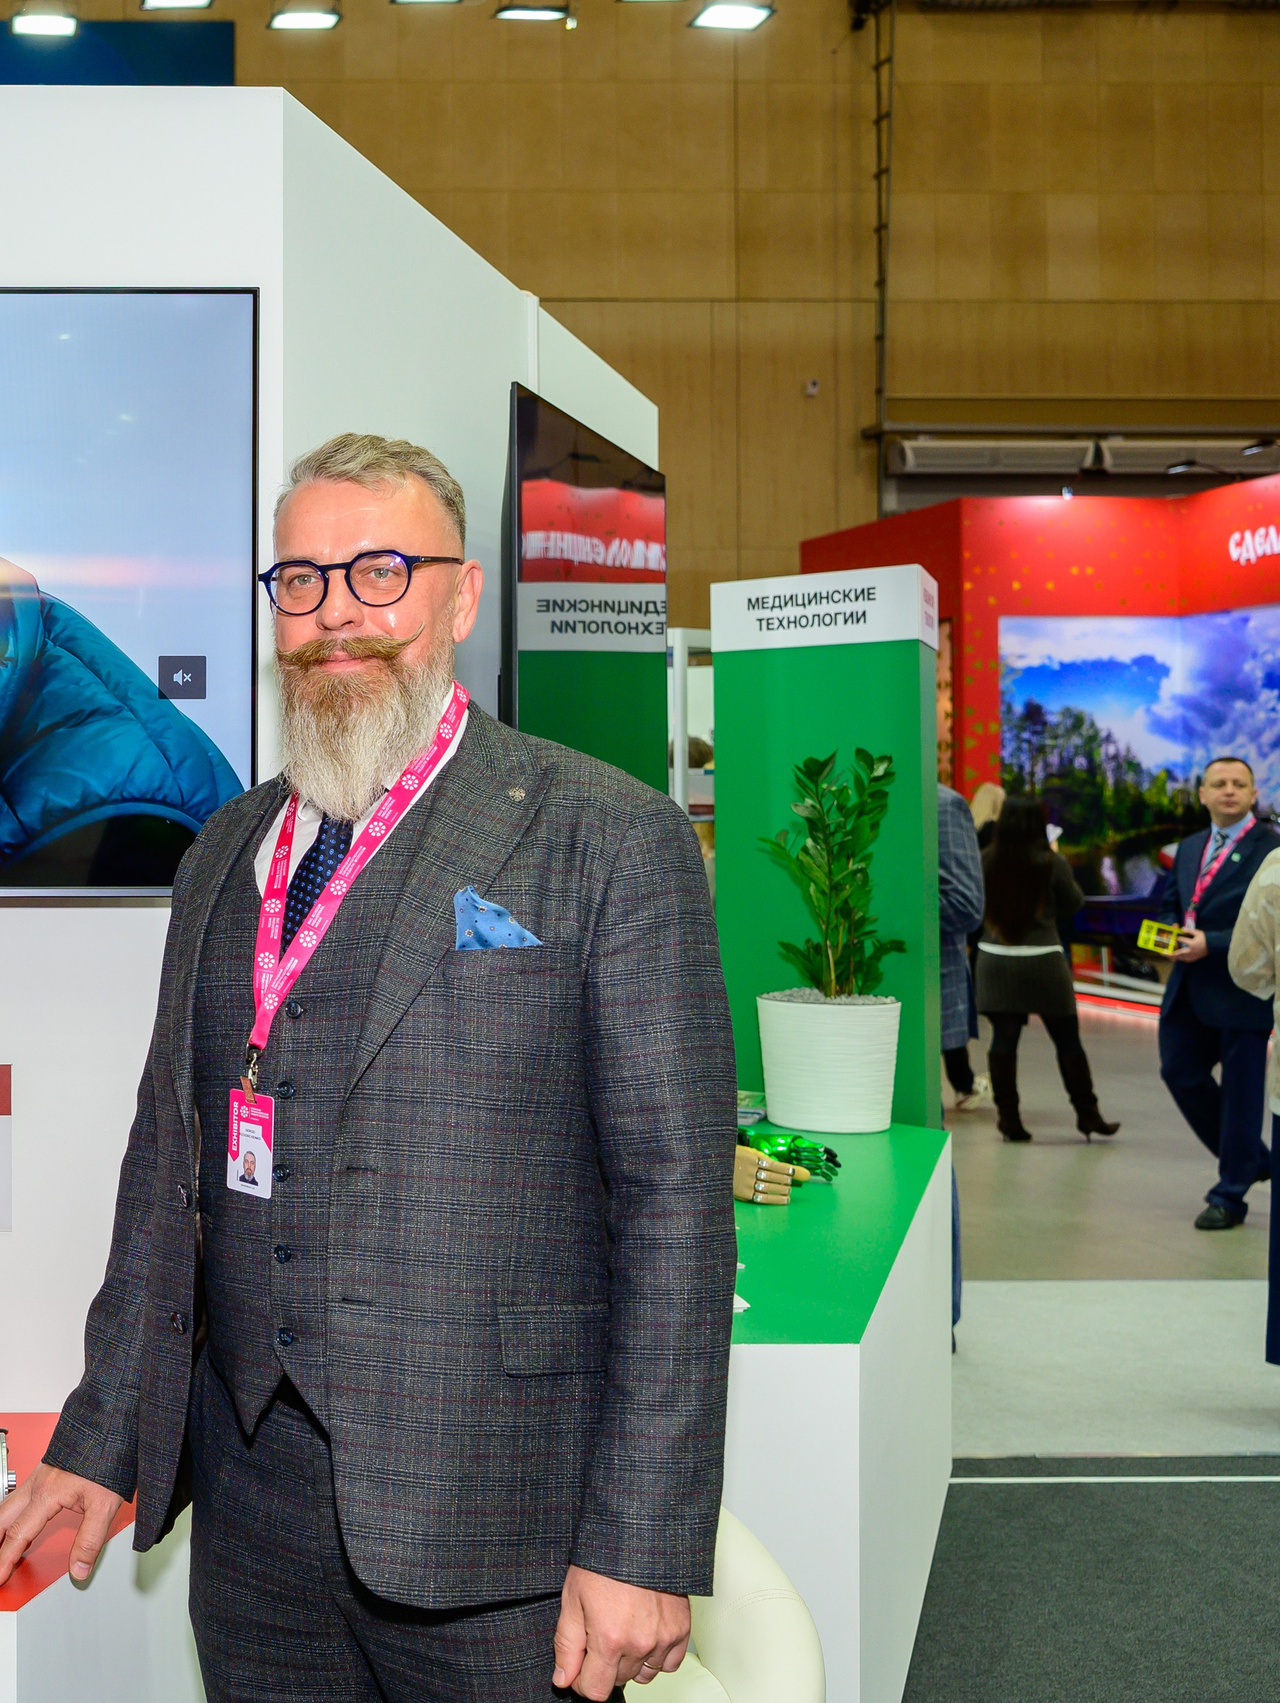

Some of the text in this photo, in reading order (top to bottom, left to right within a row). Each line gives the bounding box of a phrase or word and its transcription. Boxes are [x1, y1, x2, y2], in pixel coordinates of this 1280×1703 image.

[1228, 524, 1280, 567] СДЕЛ
[747, 587, 876, 612] МЕДИЦИНСКИЕ
[756, 610, 867, 632] ТЕХНОЛОГИИ
[231, 1102, 239, 1152] EXHIBITOR
